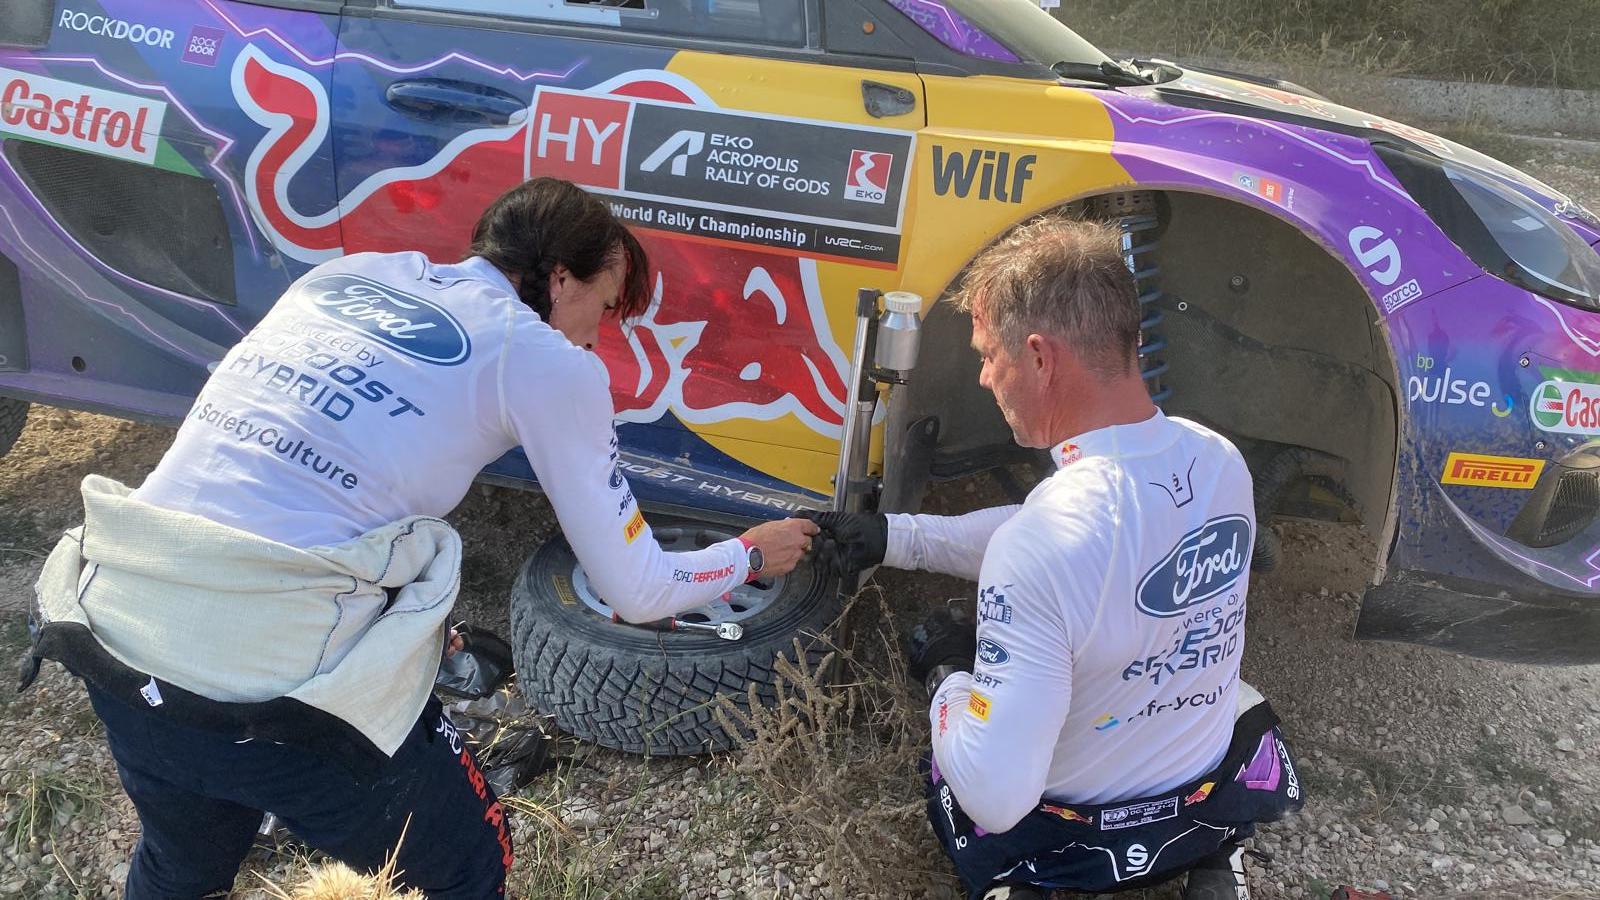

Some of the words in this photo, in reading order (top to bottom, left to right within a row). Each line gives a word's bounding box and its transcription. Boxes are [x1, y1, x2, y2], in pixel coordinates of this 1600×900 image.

[58, 9, 175, 49] ROCKDOOR
[191, 35, 217, 49] ROCK
[188, 44, 215, 57] DOOR
[1, 79, 149, 154] Castrol
[536, 113, 621, 165] HY
[709, 133, 754, 150] EKO
[706, 153, 800, 174] ACROPOLIS
[932, 144, 1037, 204] Wilf
[704, 166, 752, 188] RALLY
[756, 174, 780, 190] OF
[786, 177, 831, 197] GODS
[855, 190, 883, 201] EKO
[609, 203, 653, 222] World
[657, 209, 696, 231] Rally
[699, 215, 807, 246] Championship
[311, 284, 437, 341] Ford
[356, 346, 385, 369] by
[1416, 352, 1434, 370] bp
[229, 350, 355, 422] HYBRID
[1408, 367, 1491, 411] pulse
[198, 402, 359, 490] SafetyCulture
[1449, 459, 1536, 484] PIRELLI
